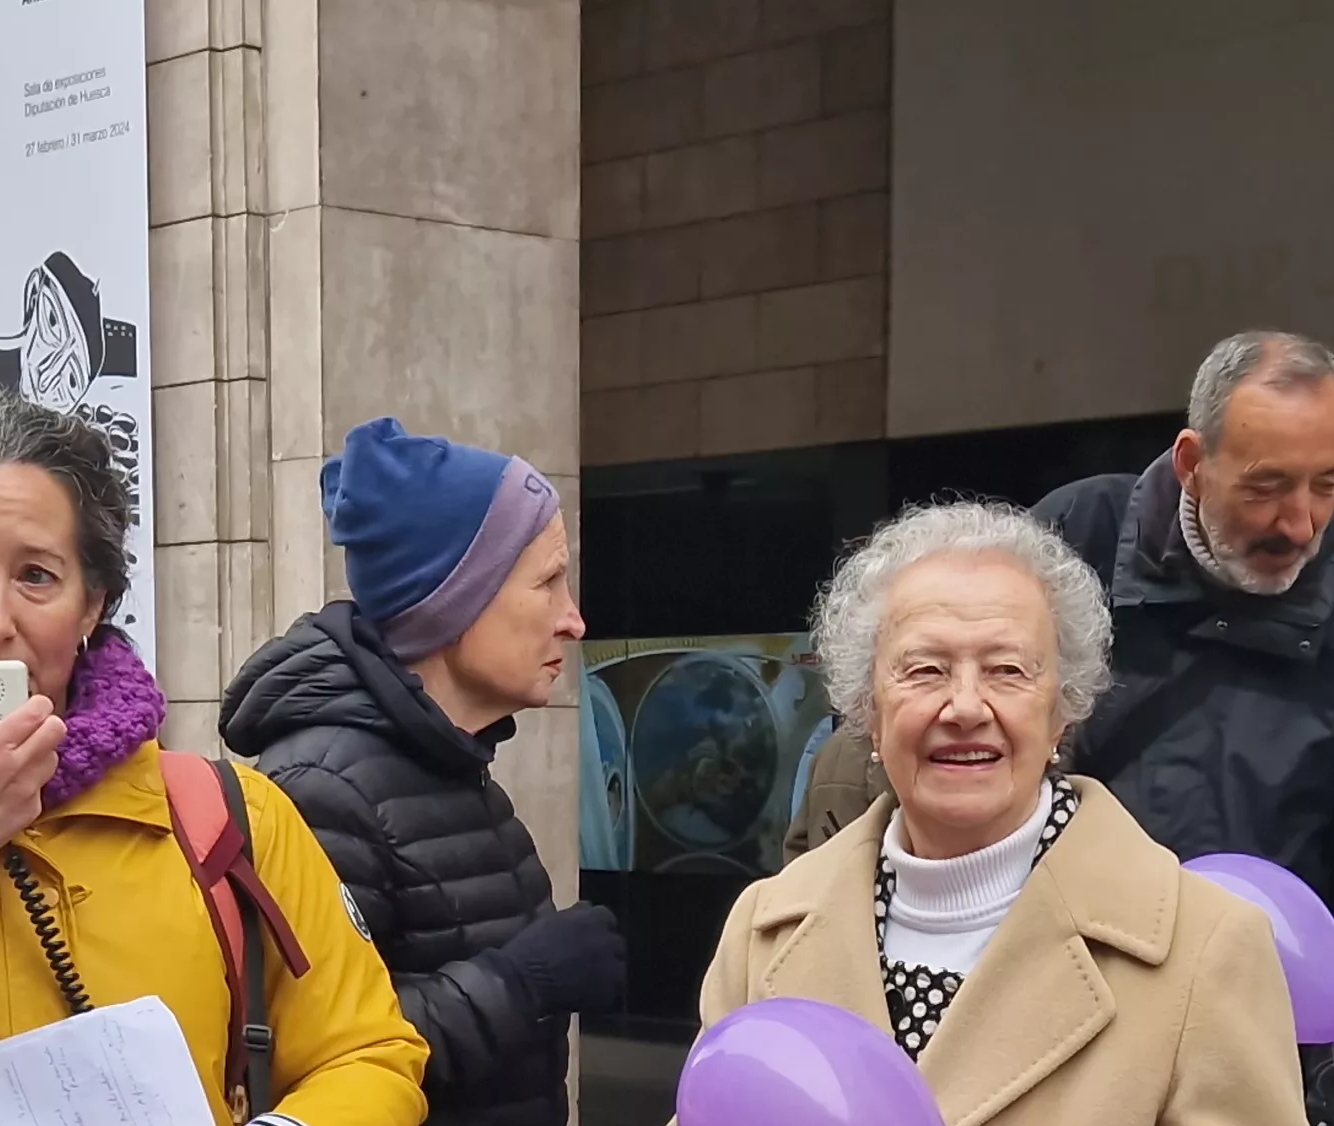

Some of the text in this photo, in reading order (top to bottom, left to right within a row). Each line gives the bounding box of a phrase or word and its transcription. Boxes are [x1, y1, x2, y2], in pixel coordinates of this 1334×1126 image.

[24, 66, 107, 98] Sala de exposiciones
[24, 86, 111, 117] Diputación de Huesca
[25, 141, 36, 157] 27
[37, 138, 64, 153] febrero
[71, 132, 81, 146] 31
[83, 128, 108, 143] marzo
[109, 120, 130, 138] 2024
